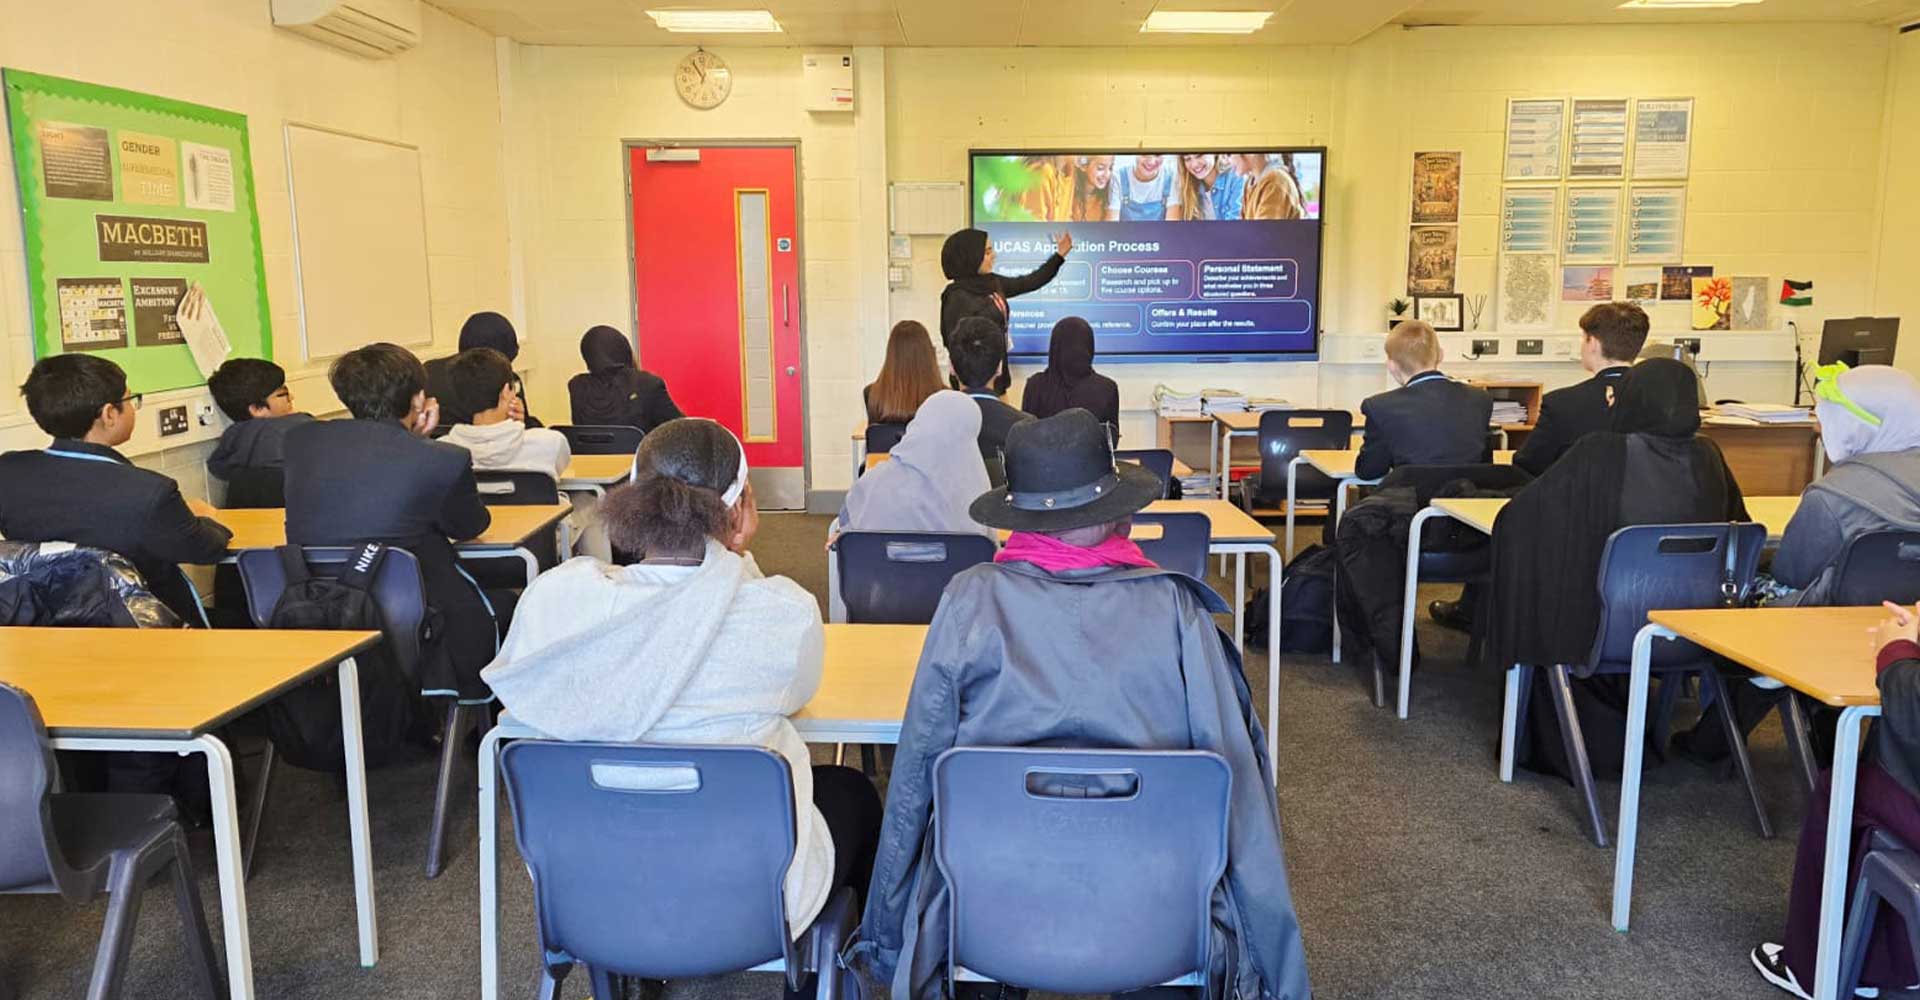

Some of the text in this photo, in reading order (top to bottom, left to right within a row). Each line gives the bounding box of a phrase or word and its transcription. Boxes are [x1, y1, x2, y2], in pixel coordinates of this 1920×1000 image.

[121, 141, 161, 156] GENDER
[101, 221, 203, 248] MACBETH
[993, 240, 1160, 256] UCAS Appation Process
[1101, 265, 1168, 273] Choose Courses
[1204, 264, 1283, 273] Personal Statement
[1147, 278, 1161, 287] pick
[133, 284, 179, 296] EXCESSIVE
[135, 298, 176, 308] AMBITION
[1151, 308, 1218, 317] Offers & Results
[1151, 320, 1175, 328] Confirm
[1176, 321, 1189, 329] your
[1190, 320, 1207, 329] place
[1208, 320, 1221, 328] after
[1222, 320, 1232, 328] the
[353, 543, 380, 573] NIKE
